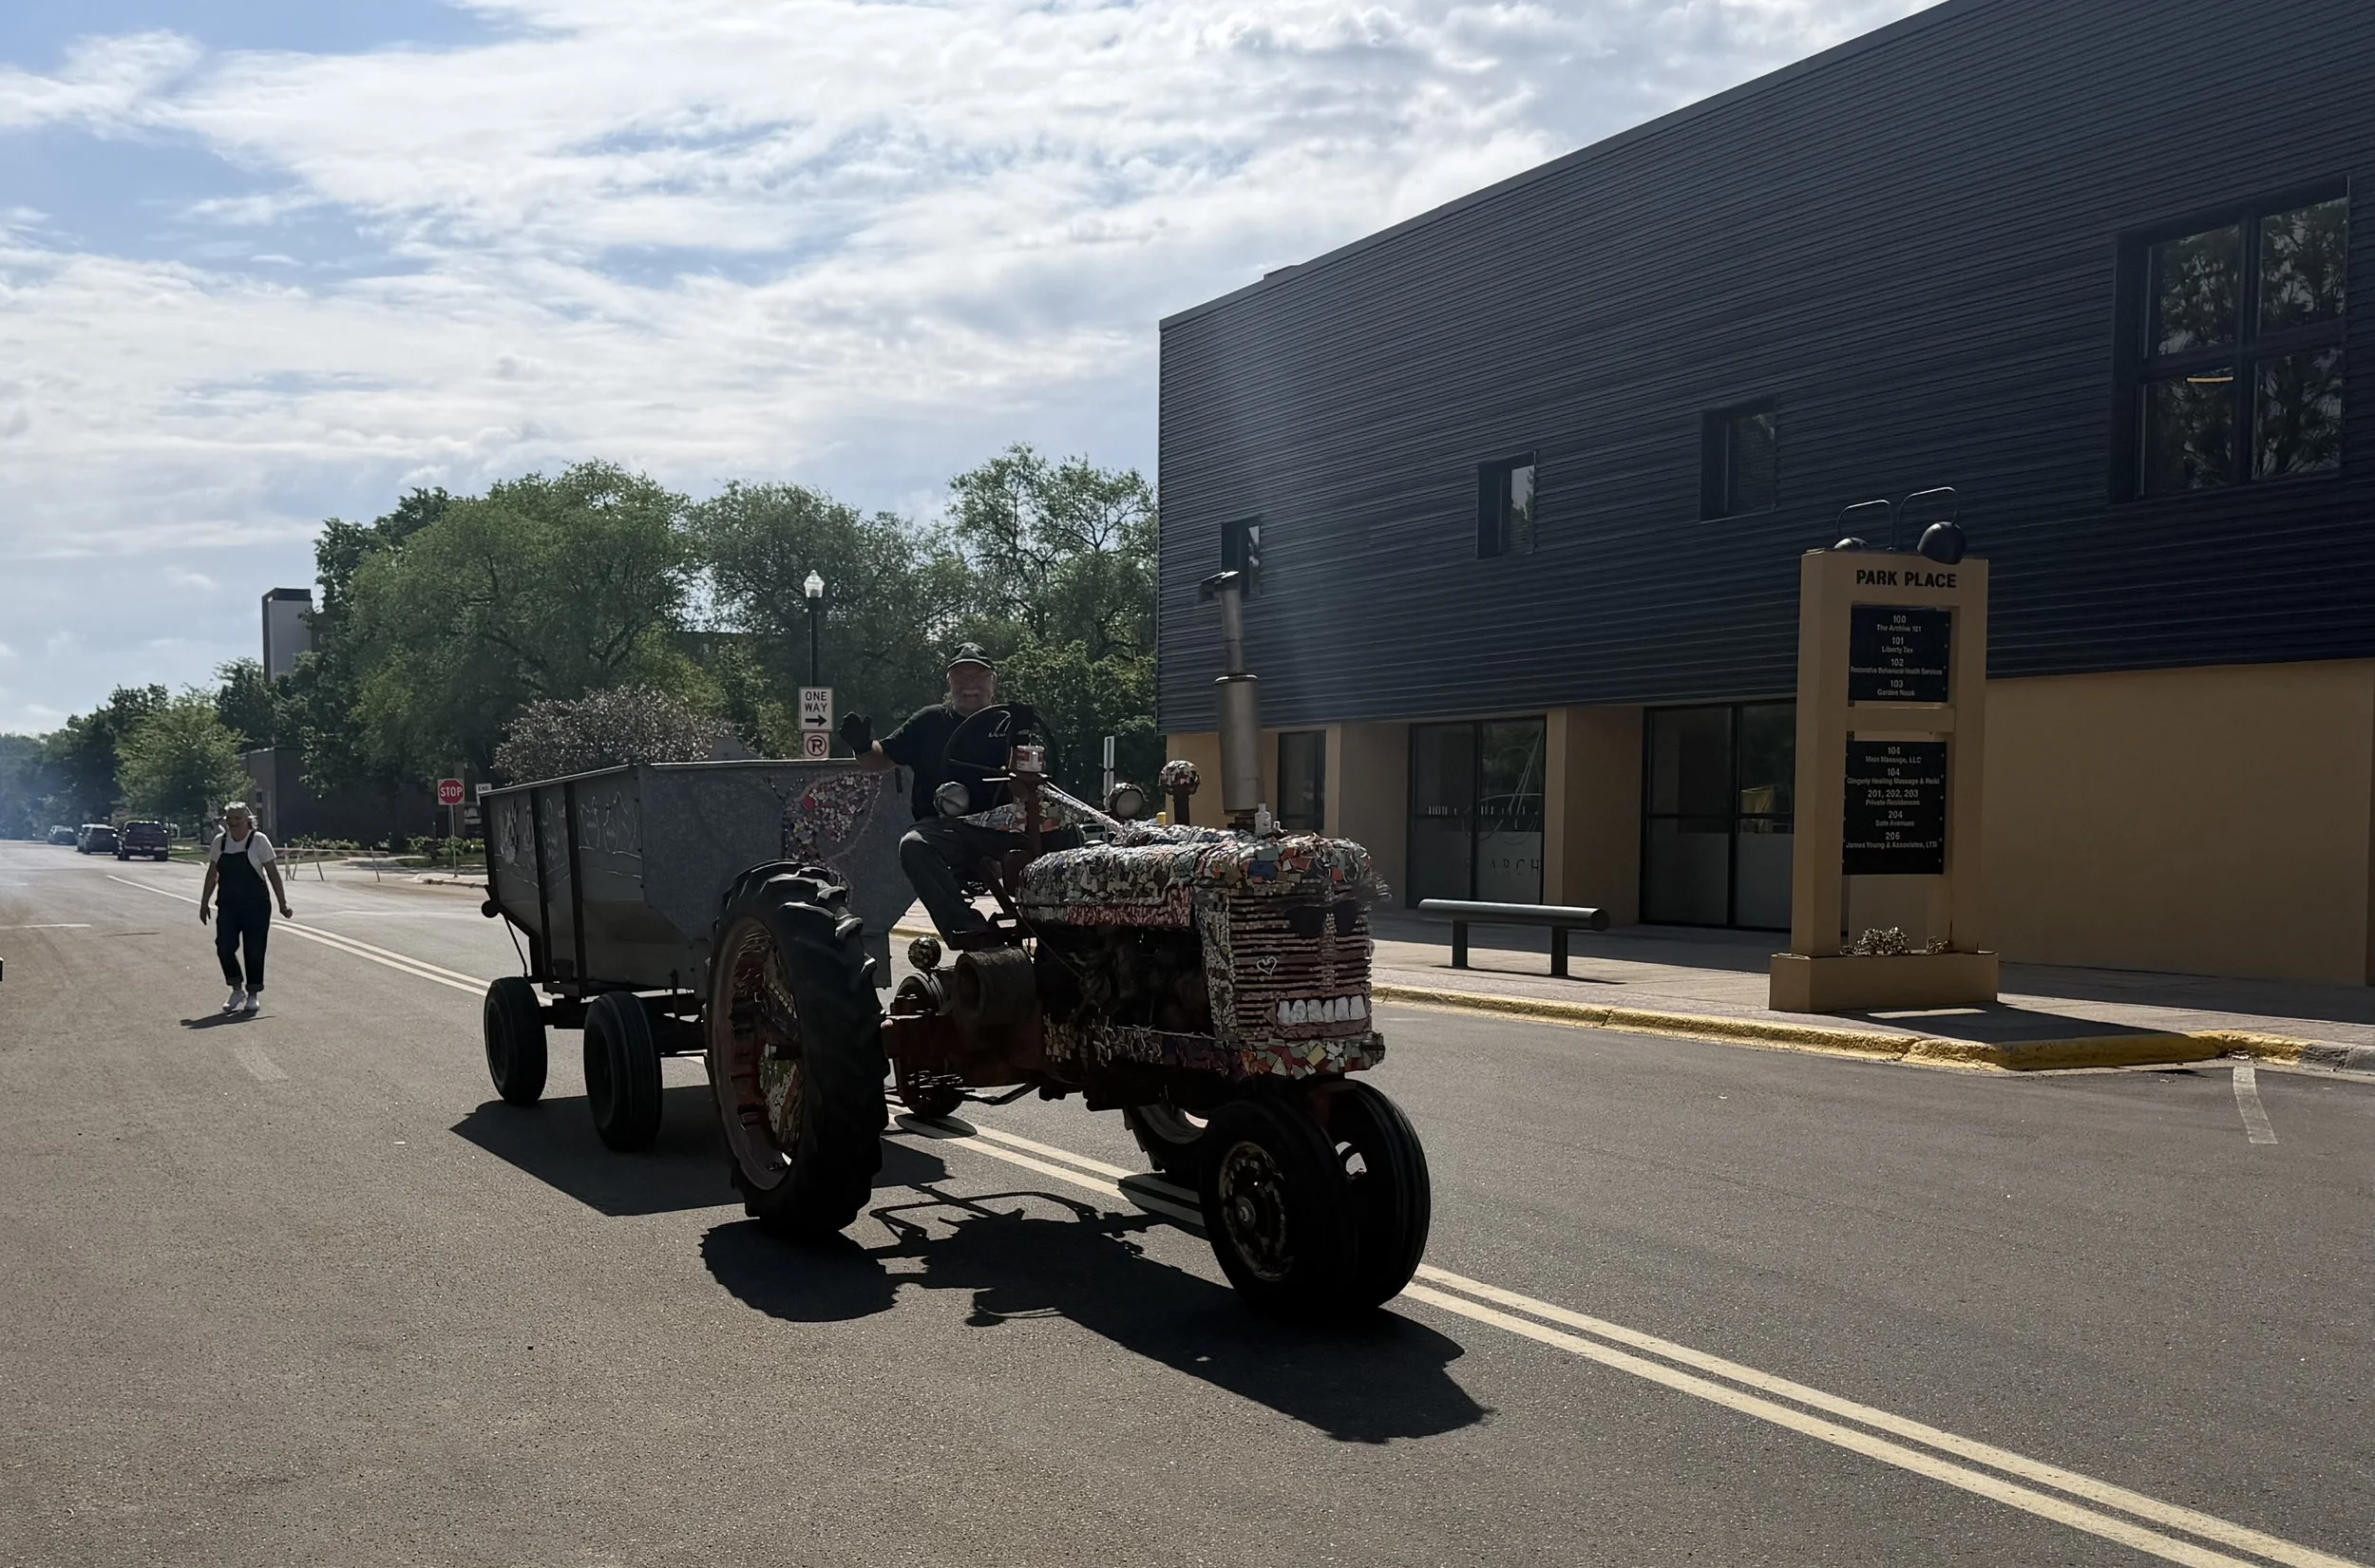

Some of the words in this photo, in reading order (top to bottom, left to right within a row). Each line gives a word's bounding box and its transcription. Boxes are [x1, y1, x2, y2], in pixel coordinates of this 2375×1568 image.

[1856, 570, 1897, 585] PARK
[1905, 572, 1956, 588] PLACE
[1892, 614, 1907, 623] 100
[1891, 636, 1904, 645] 101
[1881, 646, 1902, 654] Liberty
[1890, 658, 1904, 667] 102
[1890, 679, 1904, 688] 103
[806, 691, 827, 701] ONE
[805, 703, 827, 712] WAY
[1887, 767, 1900, 776] 104
[440, 786, 463, 797] STOP
[1867, 789, 1884, 799] 201,
[1886, 789, 1903, 799] 202,
[1904, 789, 1919, 798] 203
[1888, 810, 1903, 819] 204
